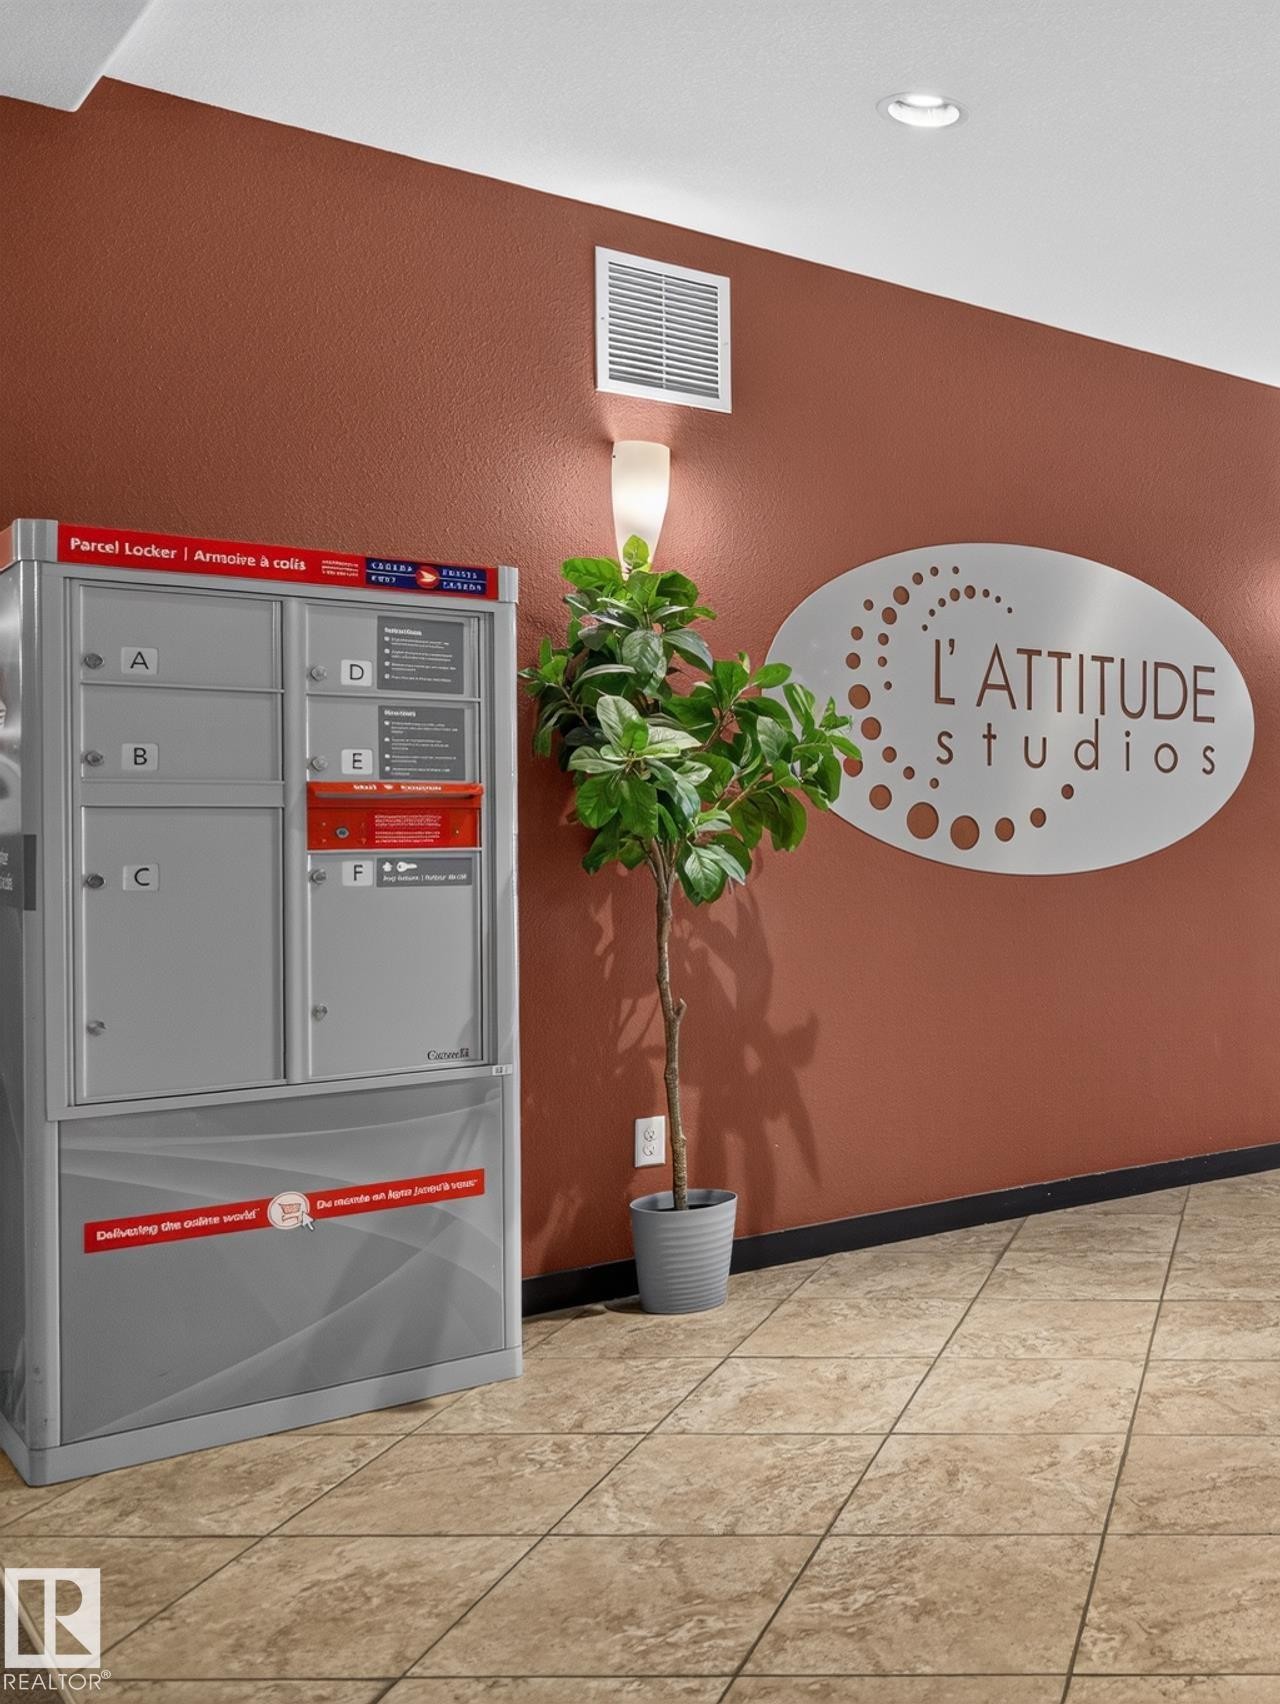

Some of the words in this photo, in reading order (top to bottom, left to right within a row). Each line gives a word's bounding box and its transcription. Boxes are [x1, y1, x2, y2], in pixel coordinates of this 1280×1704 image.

[70, 536, 119, 554] Parcel
[125, 541, 177, 559] Locker
[273, 557, 306, 571] colis
[129, 650, 150, 671] A
[350, 663, 365, 681] D
[936, 717, 1216, 776] studios
[133, 747, 148, 766] B
[352, 752, 364, 770] E
[133, 867, 151, 887] C
[353, 864, 364, 882] F
[161, 1221, 181, 1232] the
